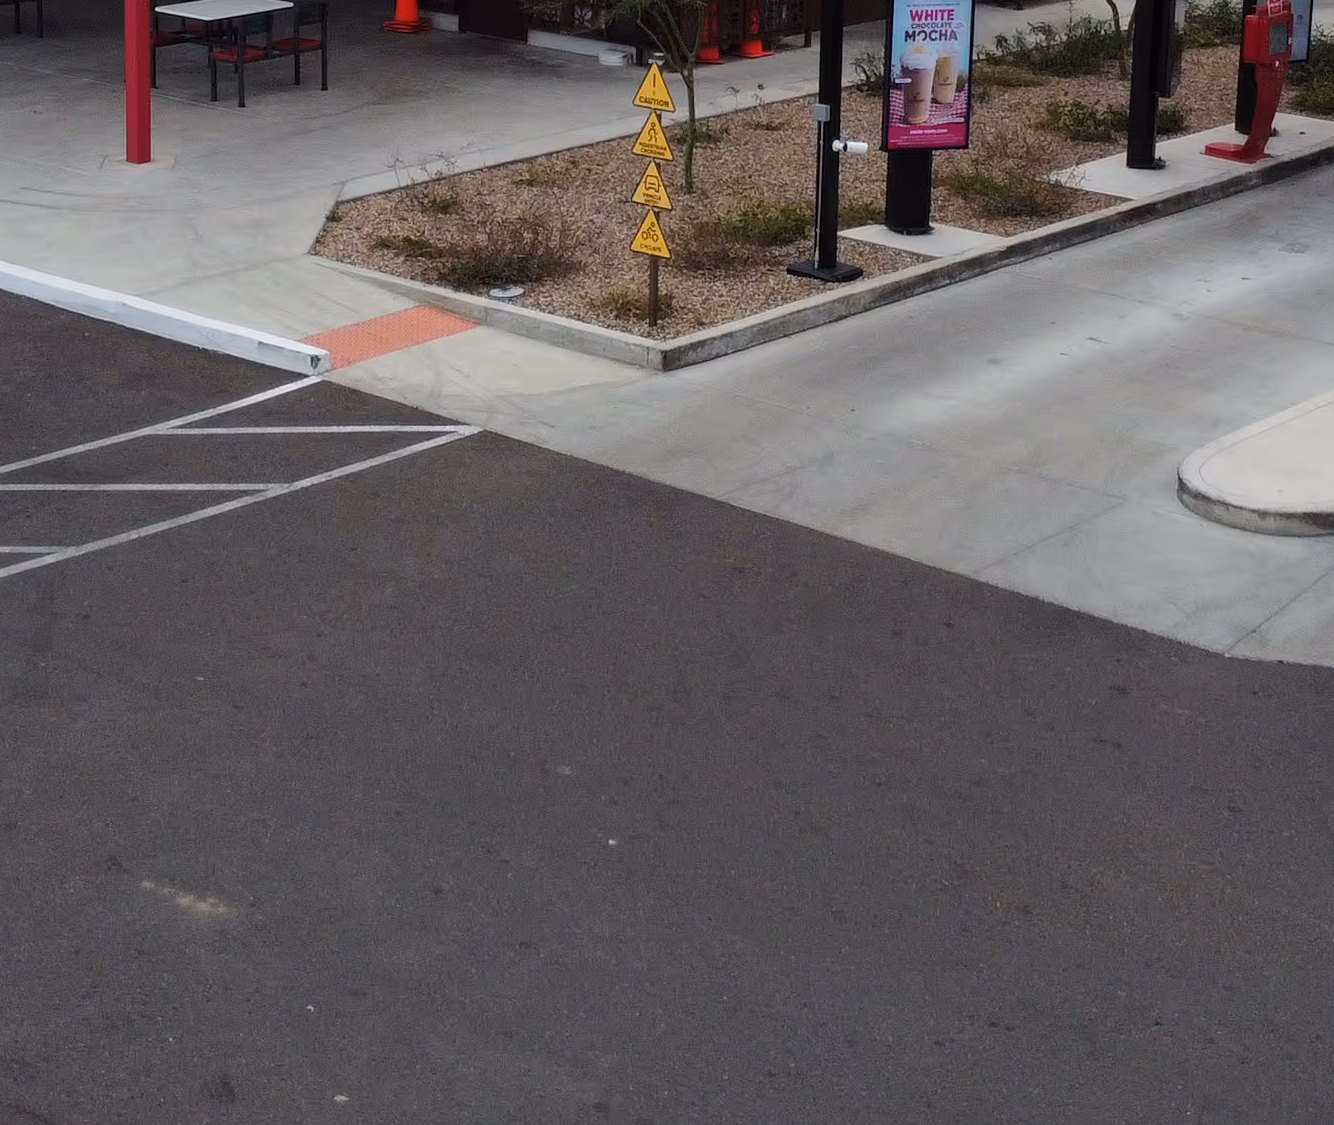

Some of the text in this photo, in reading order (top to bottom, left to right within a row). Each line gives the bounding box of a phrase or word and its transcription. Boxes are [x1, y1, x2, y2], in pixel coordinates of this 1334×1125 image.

[910, 9, 955, 21] WHITE
[904, 30, 958, 42] MOCHA
[639, 96, 669, 107] CAUTION
